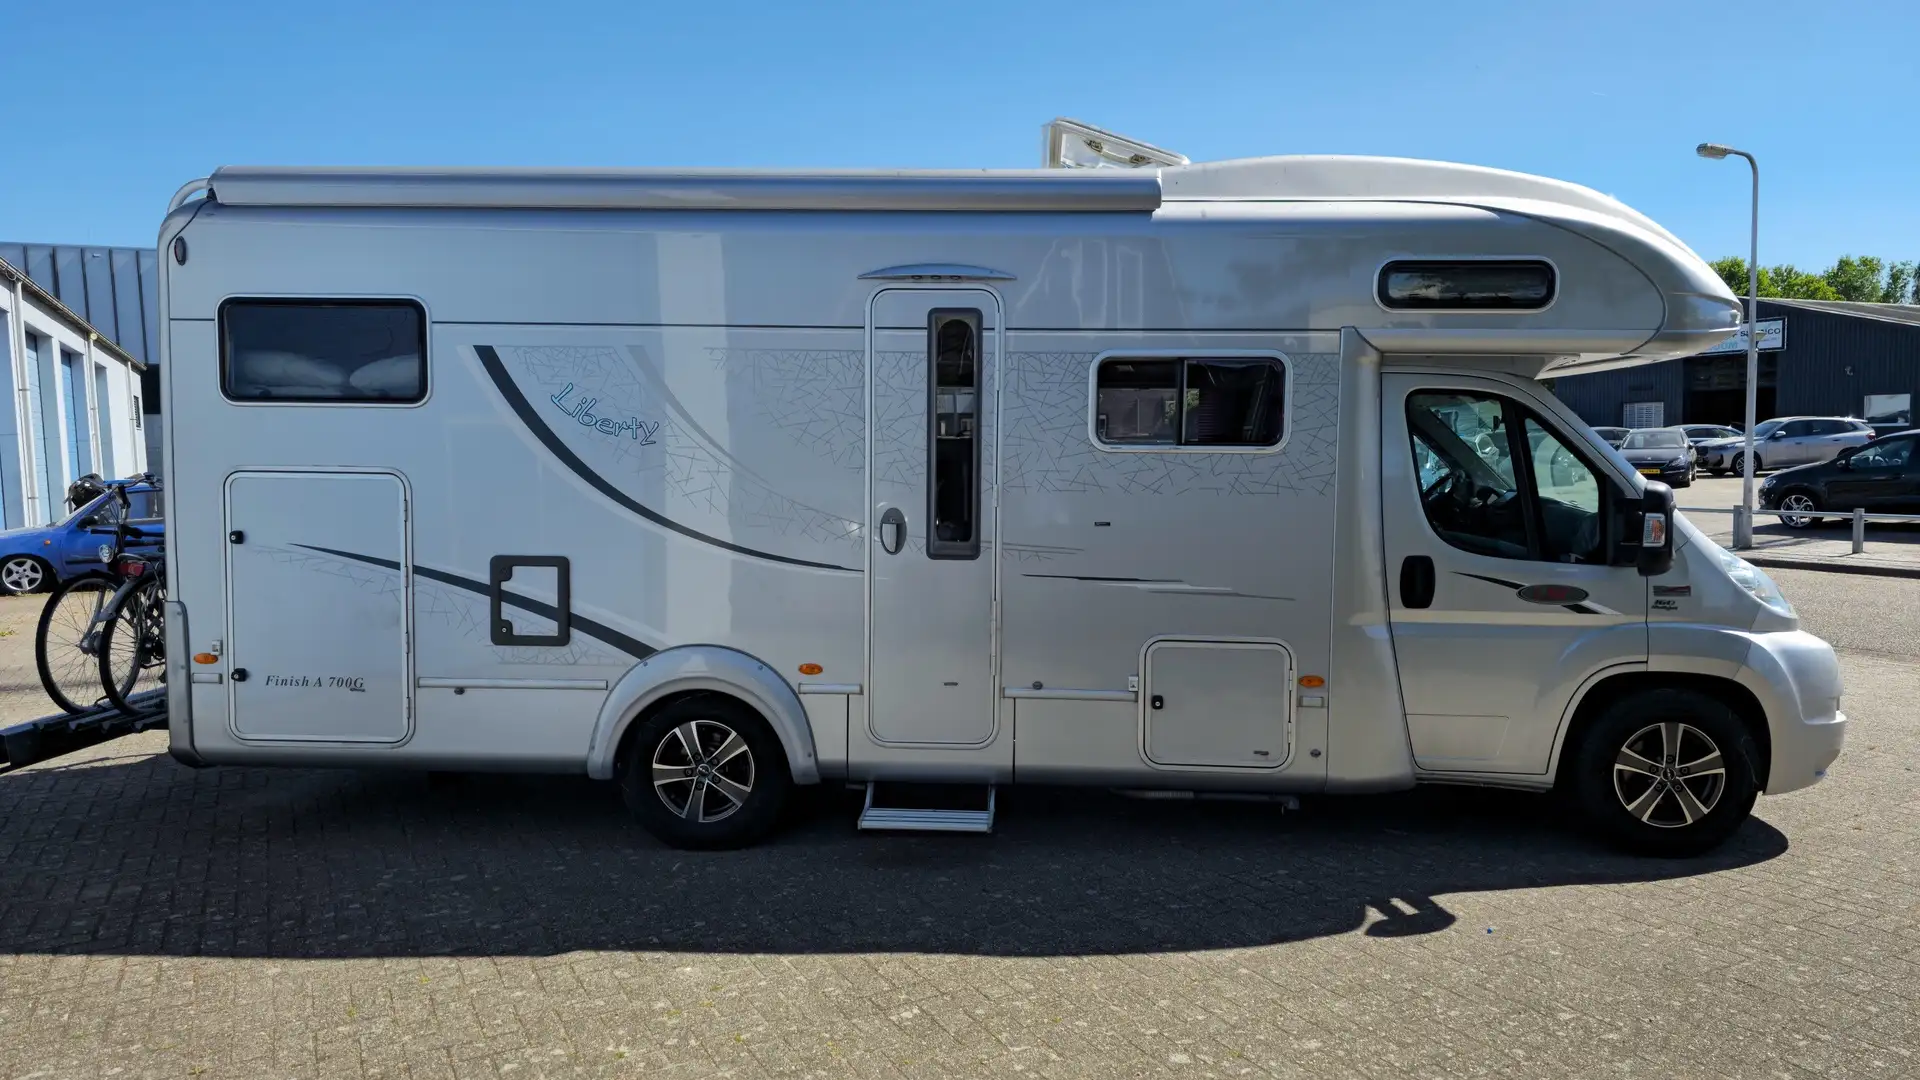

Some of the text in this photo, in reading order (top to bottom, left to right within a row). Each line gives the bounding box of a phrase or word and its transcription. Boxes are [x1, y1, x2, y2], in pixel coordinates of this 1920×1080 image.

[550, 382, 660, 446] Liberty
[265, 675, 364, 688] Finish A 700G
